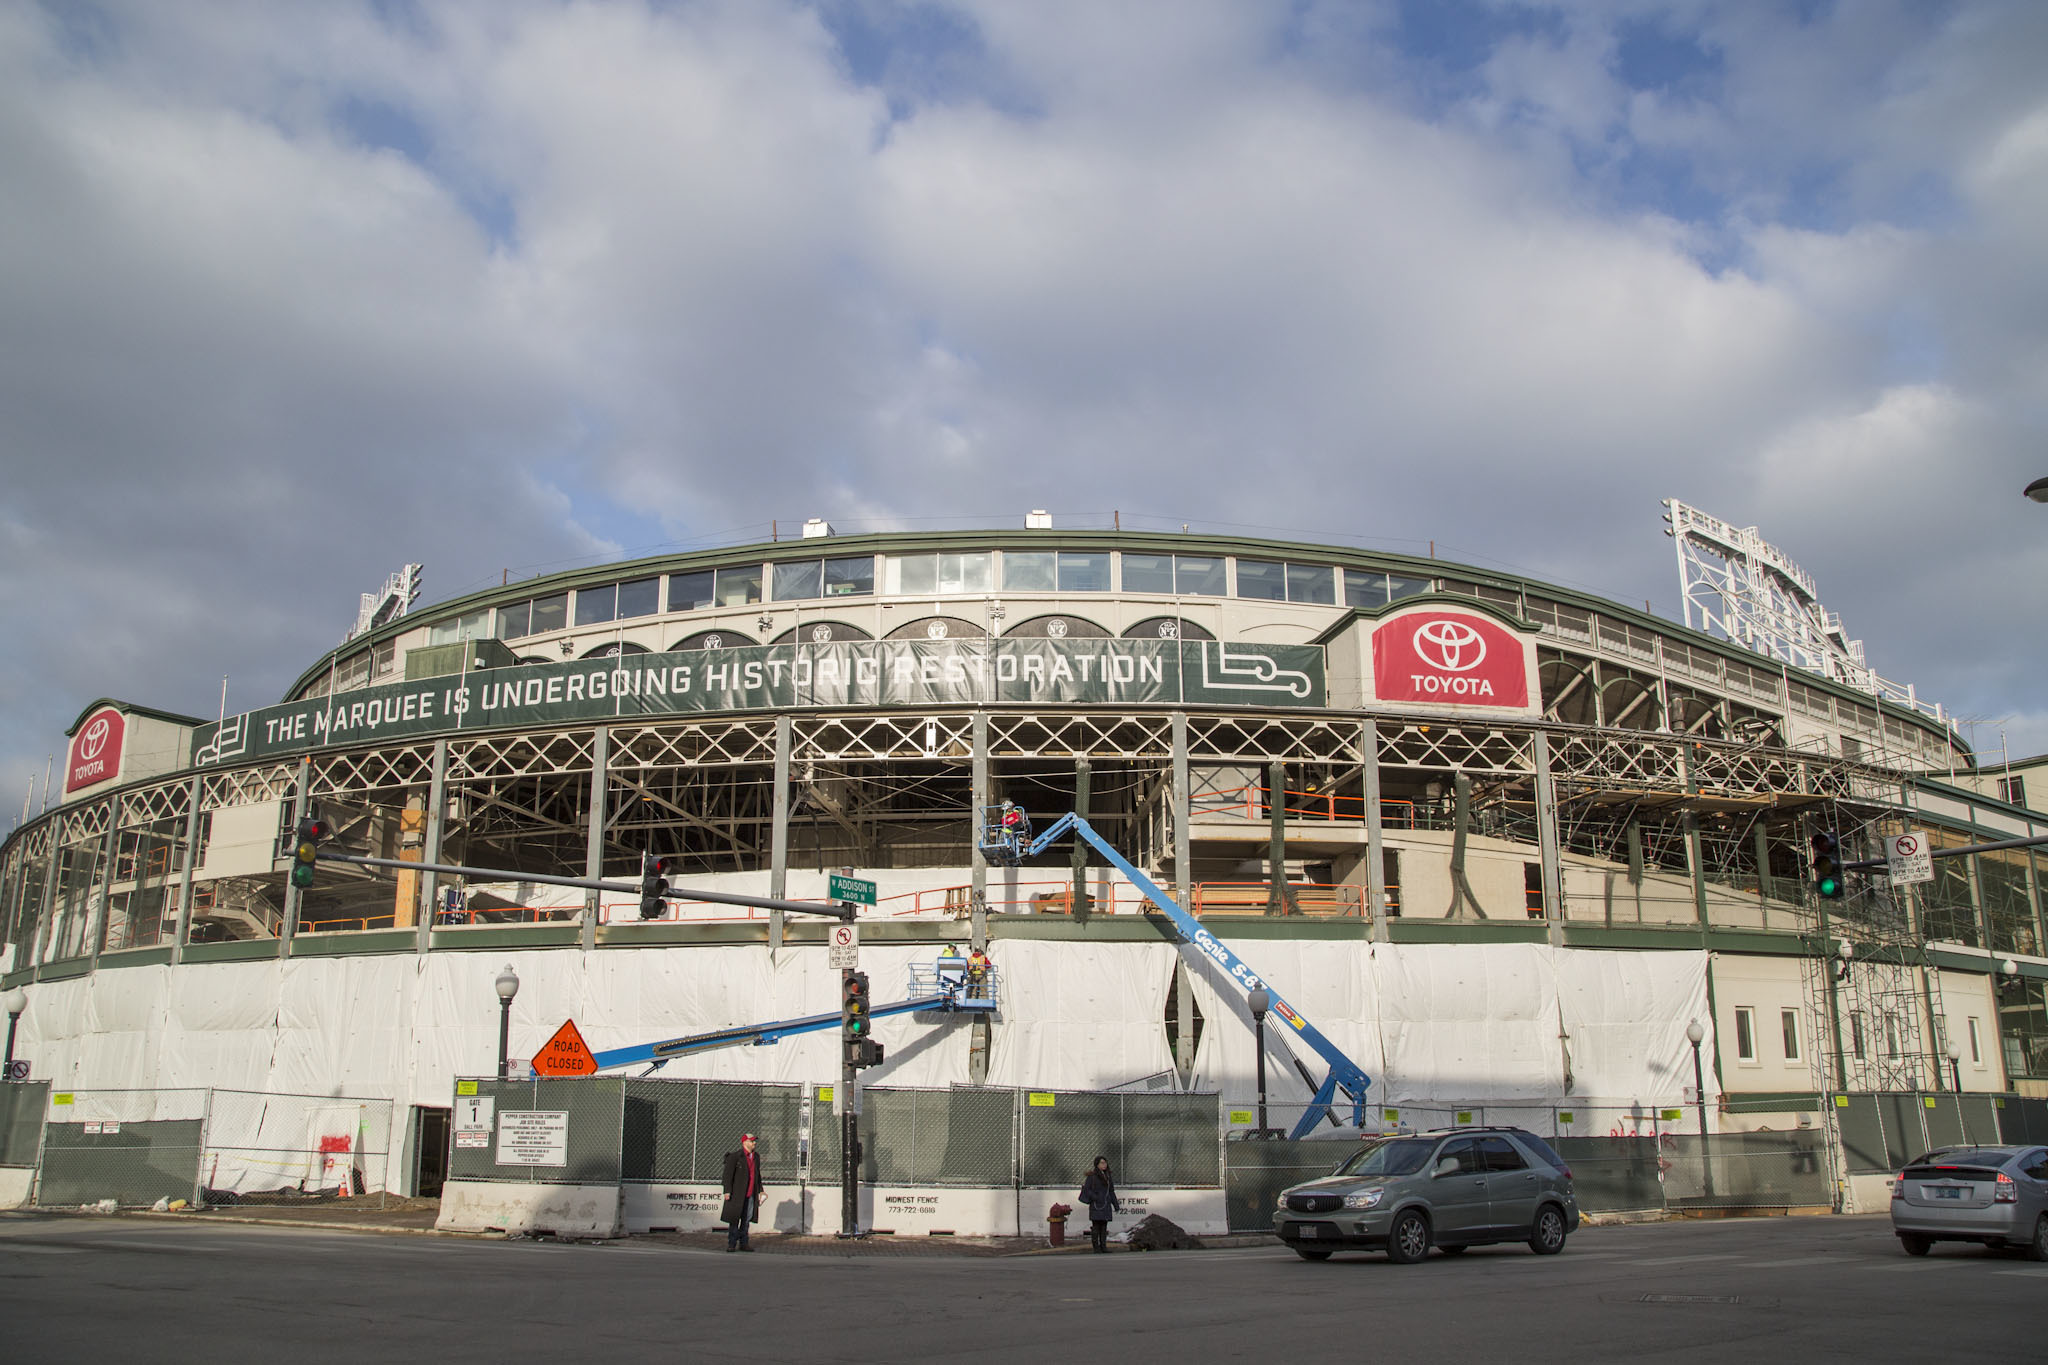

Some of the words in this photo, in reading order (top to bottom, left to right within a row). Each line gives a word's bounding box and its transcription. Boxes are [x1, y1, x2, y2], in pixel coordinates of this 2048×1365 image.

[1411, 675, 1494, 696] TOYOTA
[266, 712, 308, 744] THE
[314, 692, 435, 736] MARQUEE
[444, 687, 470, 716] IS
[481, 666, 692, 710] UNDERGOING
[706, 656, 876, 692] HISTORIC
[893, 654, 1163, 684] RESTORATION
[75, 760, 104, 781] TOYOTA
[838, 879, 868, 893] ADDISON
[869, 885, 875, 893] ST
[842, 891, 858, 900] 3600
[1194, 929, 1229, 962] Genie
[554, 1041, 580, 1053] ROAD
[547, 1057, 584, 1070] CLOSED
[472, 1107, 476, 1122] 1
[886, 1196, 915, 1204] MIDWEST
[917, 1196, 939, 1204] FENCE
